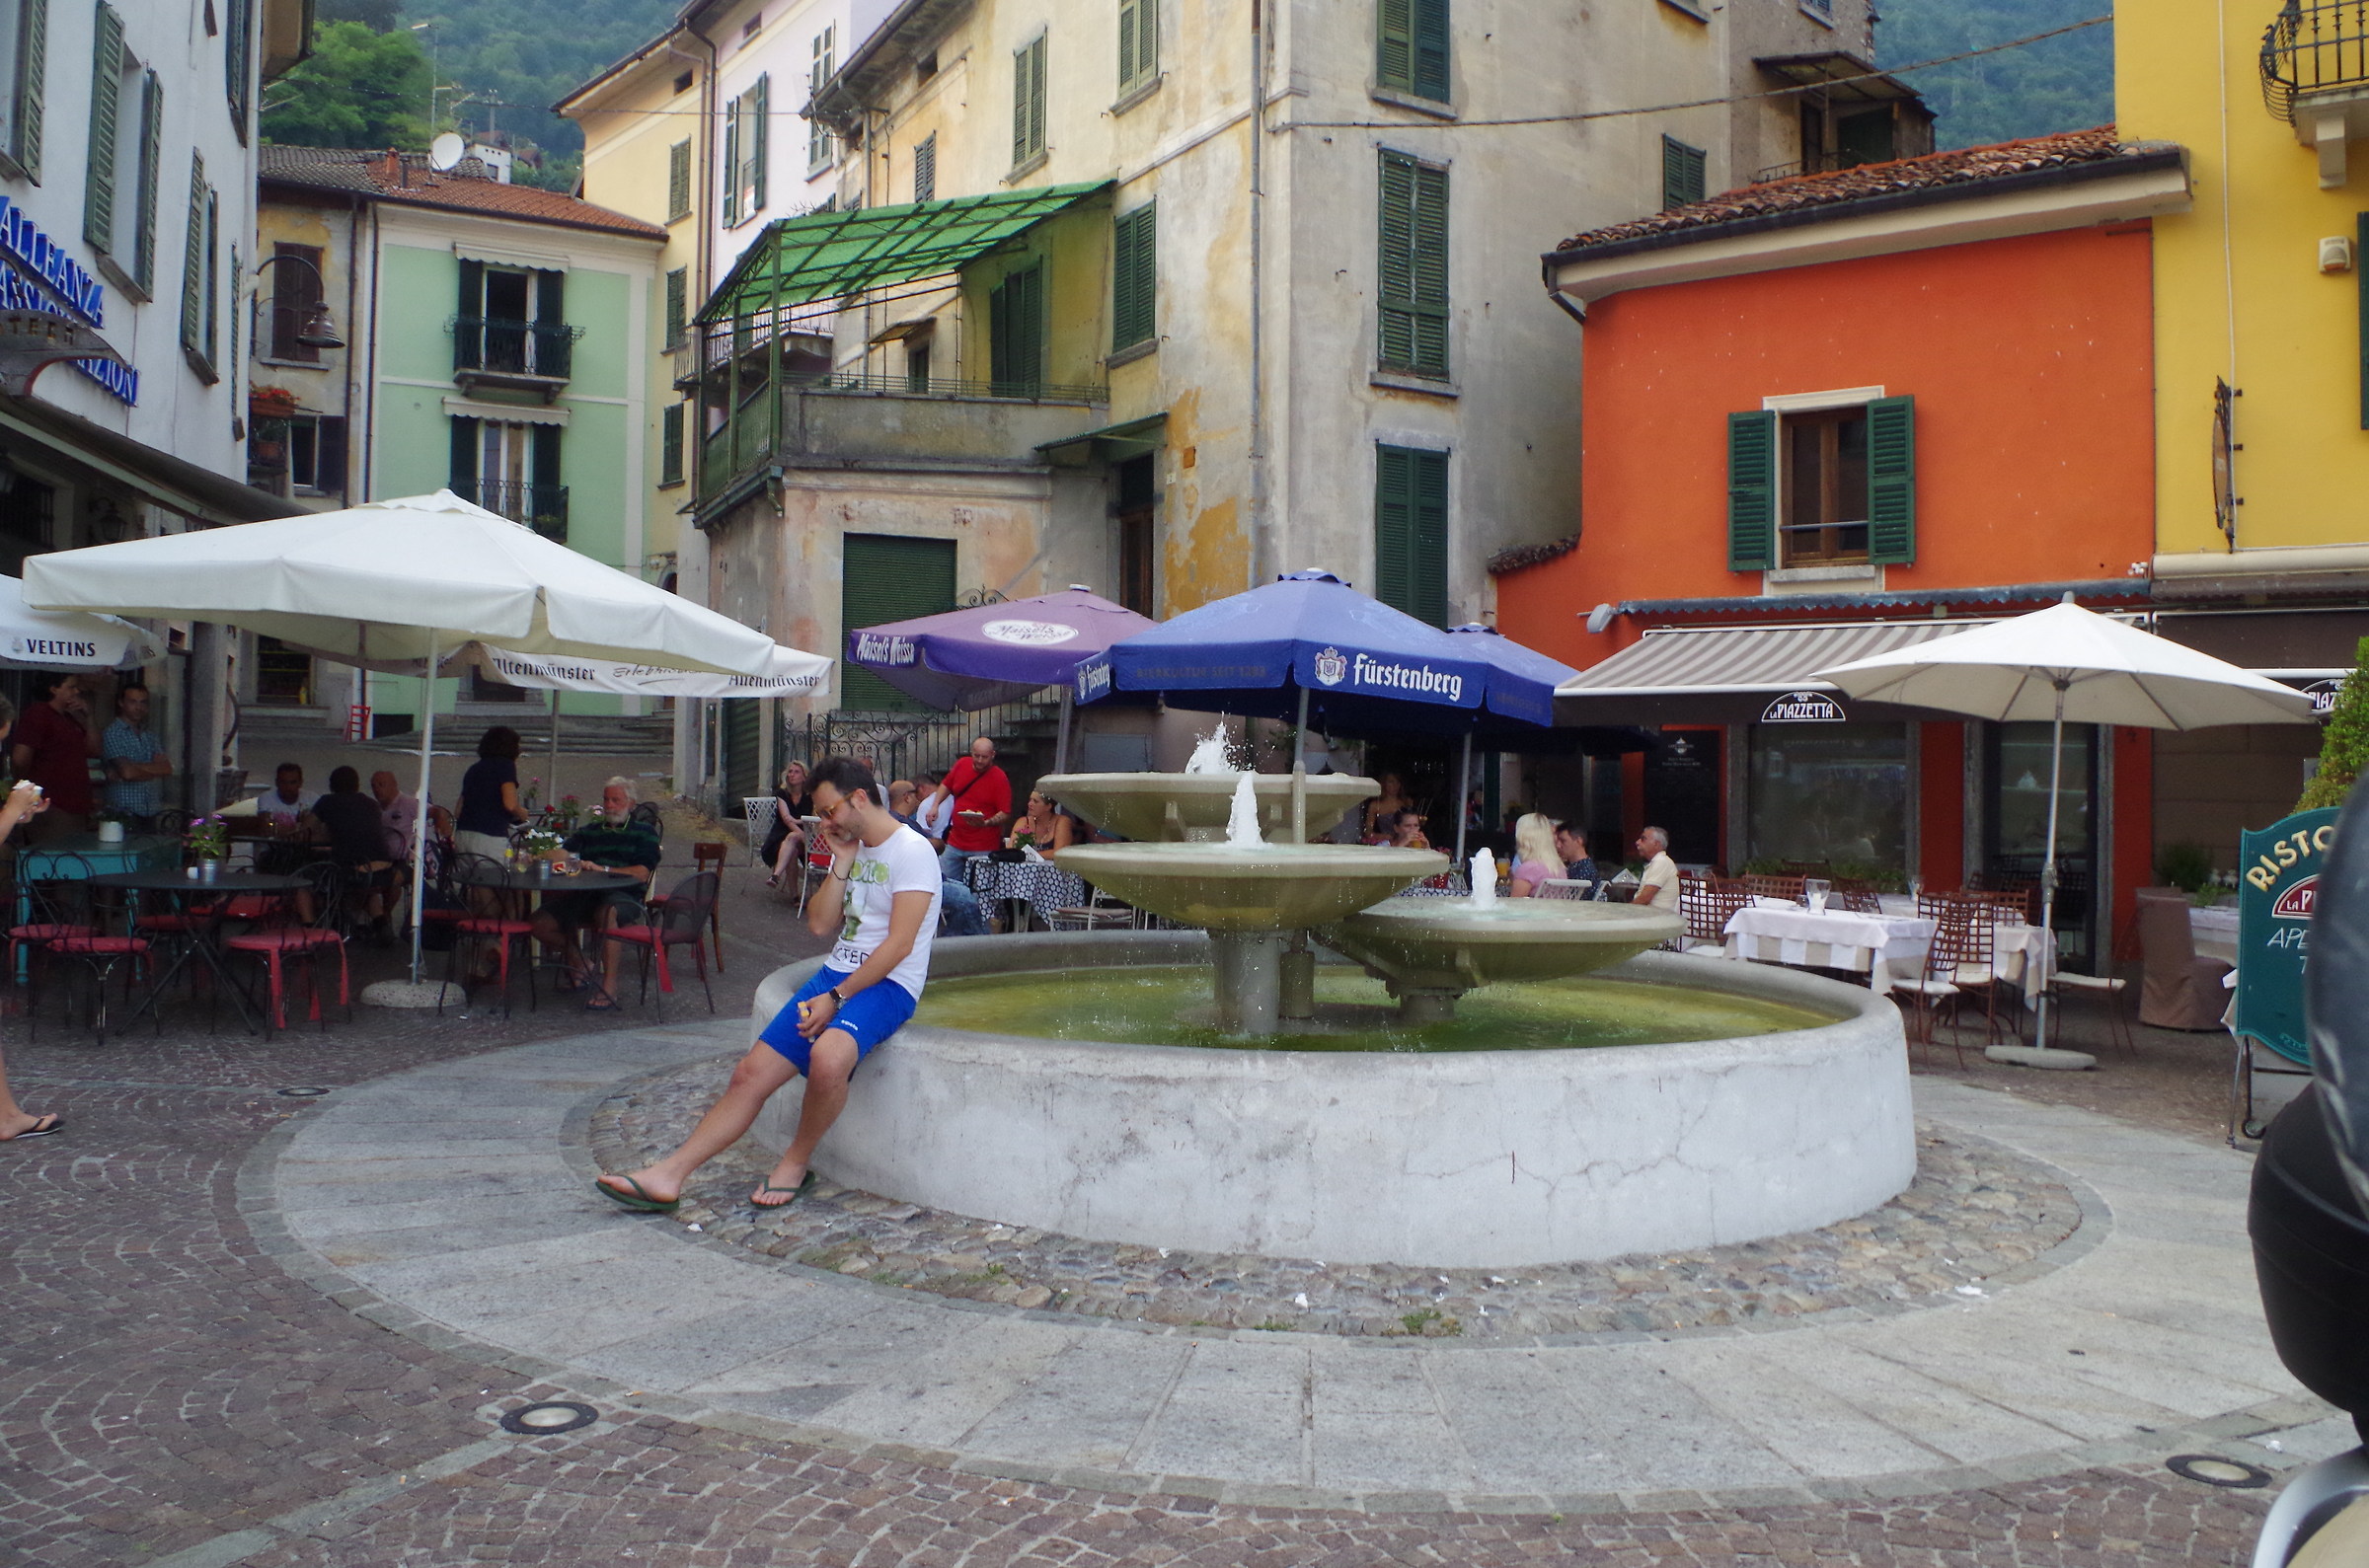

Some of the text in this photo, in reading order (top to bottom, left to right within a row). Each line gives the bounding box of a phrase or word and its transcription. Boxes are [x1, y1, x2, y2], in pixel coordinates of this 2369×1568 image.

[27, 638, 96, 657] VELTINS
[1353, 652, 1462, 702] Fürstenberg
[1777, 703, 1833, 718] PIAZZETTA
[2246, 825, 2335, 892] RISTO
[2286, 899, 2299, 911] LA
[2266, 927, 2311, 949] APE
